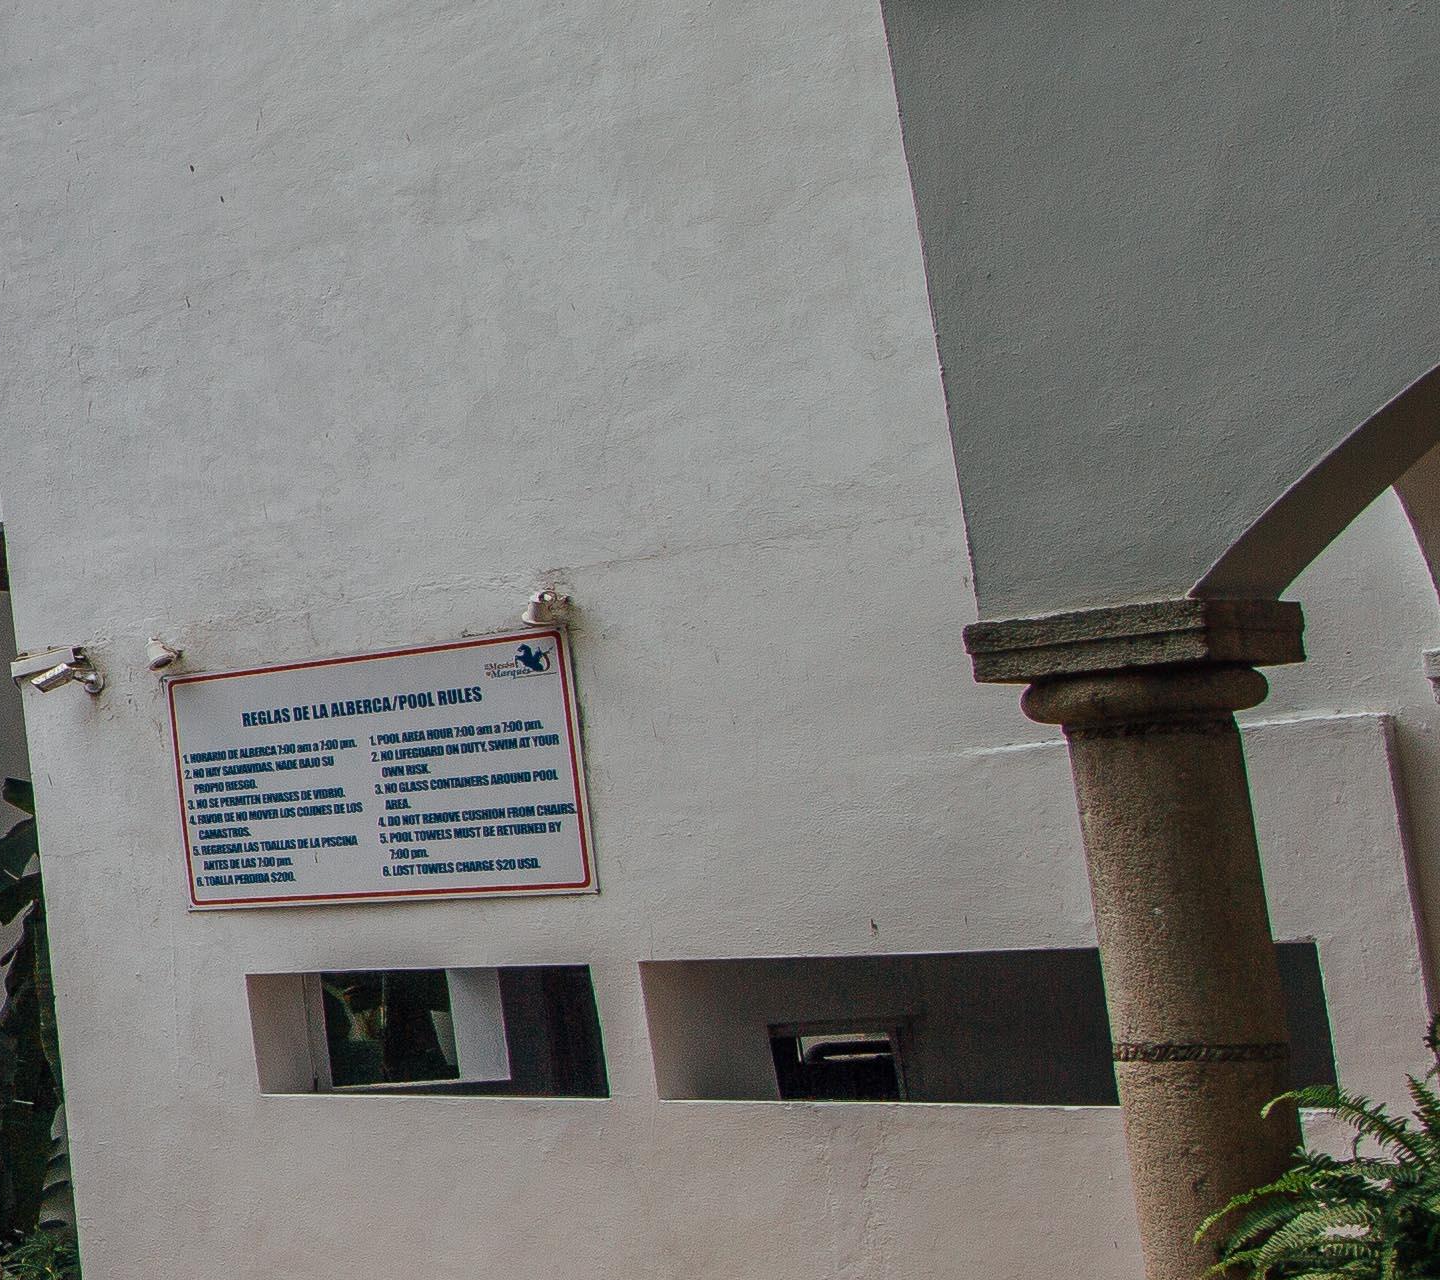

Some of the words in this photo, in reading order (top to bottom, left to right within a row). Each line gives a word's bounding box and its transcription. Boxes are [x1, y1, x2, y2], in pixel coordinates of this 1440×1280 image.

[242, 708, 290, 727] REGLAS
[294, 705, 310, 721] DE
[312, 703, 329, 719] LA
[330, 692, 435, 717] ALBERCA/POOL
[438, 686, 482, 705] RULES
[369, 736, 376, 746] 1.
[377, 733, 400, 745] POOL
[402, 731, 425, 743] AREA
[427, 728, 453, 741] HOUR
[455, 726, 475, 738] 7:00
[477, 726, 492, 735] am
[495, 725, 500, 733] a
[502, 721, 523, 733] 7:00
[525, 720, 543, 732] pm.
[183, 755, 189, 764] 1.
[190, 751, 226, 763] HORARIO
[228, 749, 239, 760] DE
[240, 746, 277, 759] ALBERCA
[278, 744, 296, 755] 7:00
[297, 744, 311, 753] am
[313, 742, 318, 751] a
[320, 739, 338, 751] 7:00
[340, 739, 357, 750] pm.
[371, 752, 379, 762] 2.
[381, 750, 394, 761] NO
[395, 745, 444, 760] LIFEGUARD
[446, 744, 459, 755] ON
[488, 739, 518, 751] SWIM
[519, 737, 530, 748] AT
[532, 734, 559, 747] YOUR
[184, 769, 192, 779] 2.
[193, 768, 204, 778] NO
[206, 766, 222, 777] HAY
[276, 759, 297, 771] NADE
[299, 757, 320, 769] BAJO
[322, 756, 334, 766] SU
[382, 765, 404, 778] OWN
[406, 764, 431, 776] RISK.
[194, 783, 224, 794] PROPIO
[225, 779, 257, 792] RIESGO.
[375, 784, 383, 795] 3.
[384, 783, 397, 794] NO
[399, 779, 429, 793] GLASS
[430, 775, 489, 790] CONTAINERS
[491, 771, 531, 785] AROUND
[533, 769, 559, 782] POOL
[188, 800, 195, 810] 3.
[196, 799, 208, 809] NO
[209, 798, 220, 808] SE
[220, 794, 261, 807] PERMITEN
[263, 790, 299, 804] ENVASES
[301, 789, 312, 800] DE
[313, 787, 345, 799] VIDRIO.
[385, 799, 411, 810] AREA.
[189, 816, 196, 825] 4.
[197, 813, 223, 824] FAVOR
[225, 812, 235, 822] DE
[236, 812, 248, 821] NO
[249, 809, 279, 820] MOVER
[280, 807, 296, 818] LOS
[297, 804, 332, 817] COJINES
[333, 804, 345, 814] DE
[347, 802, 363, 813] LOS
[378, 816, 386, 827] 4.
[388, 815, 401, 826] DO
[402, 814, 420, 826] NOT
[422, 811, 461, 824] REMOVE
[462, 808, 505, 821] CUSHION
[507, 805, 535, 818] FROM
[537, 803, 577, 817] CHAIRS.
[199, 827, 251, 840] CAMASTROS.
[379, 833, 388, 844] 5.
[389, 832, 413, 844] POOL
[414, 828, 452, 842] TOWELS
[454, 827, 481, 839] MUST
[483, 825, 495, 837] BE
[497, 822, 546, 836] RETURNED
[549, 821, 562, 832] BY
[193, 846, 201, 856] 5.
[201, 843, 243, 855] REGRESAR
[244, 841, 259, 852] LAS
[260, 839, 297, 851] TOALLAS
[298, 837, 309, 848] DE
[310, 836, 321, 847] LA
[321, 835, 358, 847] PISCINA
[389, 848, 410, 860] 7:00
[411, 849, 429, 860] pm.
[204, 859, 229, 871] ANTES
[230, 858, 240, 869] DE
[241, 857, 257, 868] LAS
[258, 857, 275, 867] 7:00
[277, 857, 293, 867] pm.
[382, 866, 391, 877] 6.
[392, 864, 414, 876] LOST
[416, 862, 455, 874] TOWELS
[456, 859, 494, 872] CHARGE
[495, 858, 516, 871] $20
[517, 858, 541, 870] USD.
[197, 876, 204, 887] 6.
[205, 874, 234, 886] TOALLA
[235, 872, 270, 885] PERDIDA
[271, 871, 296, 883] $200.
